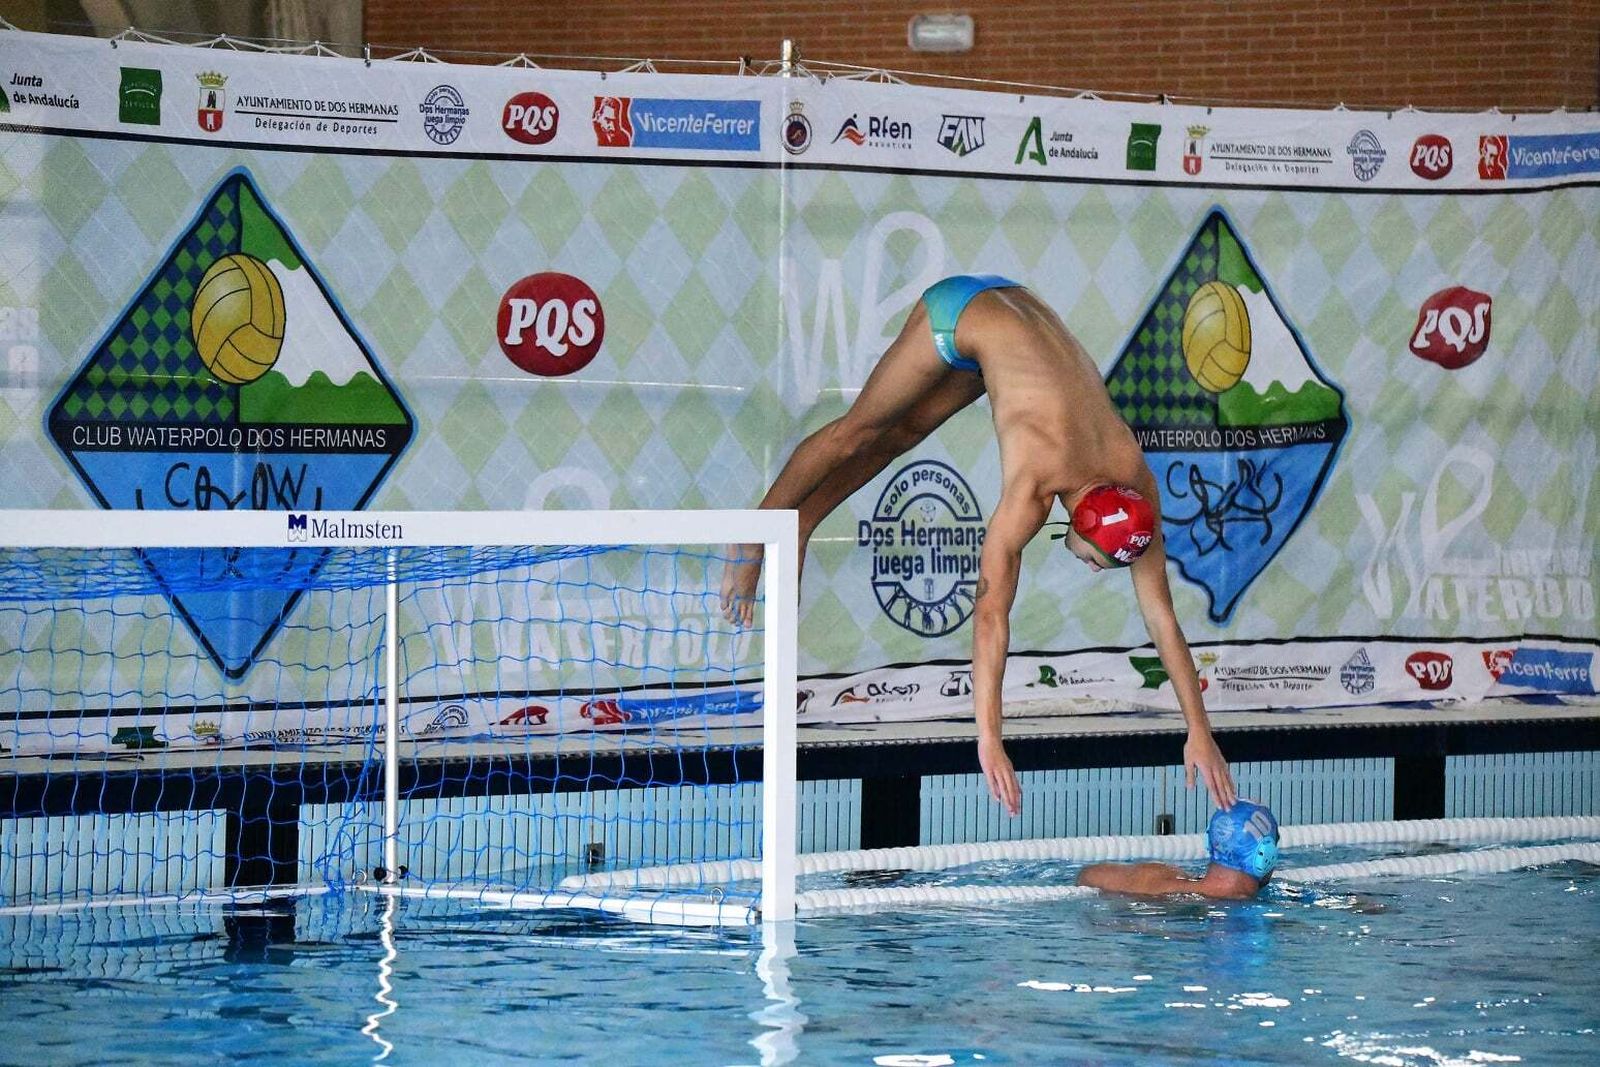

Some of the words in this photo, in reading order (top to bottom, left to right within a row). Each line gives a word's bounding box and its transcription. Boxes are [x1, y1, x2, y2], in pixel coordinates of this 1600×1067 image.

[10, 73, 43, 87] Junta
[13, 91, 27, 104] de
[29, 93, 80, 109] Andalucía
[236, 95, 312, 111] AYUNTAMIENTO
[314, 100, 326, 112] DE
[328, 101, 347, 113] DOS
[348, 102, 399, 116] HERMANAS
[434, 105, 470, 116] Hermanas
[255, 117, 311, 132] Delegación
[316, 120, 328, 132] de
[333, 122, 377, 135] Deportes
[505, 104, 556, 136] PQS
[636, 111, 755, 136] VicenteFerrer
[1049, 131, 1073, 141] Junta
[1049, 147, 1059, 157] de
[1060, 147, 1099, 159] Andalucía
[1210, 143, 1266, 155] AYUNTAMIENTO
[1267, 145, 1276, 155] DE
[1278, 145, 1292, 156] DOS
[1293, 147, 1332, 157] HERMANAS
[1412, 144, 1450, 172] PQS
[504, 298, 596, 357] PQS
[1412, 302, 1490, 353] PQS
[72, 425, 122, 447] CLUB
[128, 427, 241, 448] WATERPOLO
[247, 428, 285, 448] DOS
[290, 428, 387, 449] HERMANAS
[1136, 429, 1221, 449] WATERPOLO
[1225, 429, 1256, 447] DOS
[883, 479, 909, 516] solo
[911, 468, 971, 515] personas
[1101, 507, 1129, 526] 1
[310, 518, 404, 539] Malmsten
[858, 519, 894, 547] Dos
[900, 519, 986, 547] Hermana
[1129, 534, 1152, 548] PQS
[871, 546, 925, 581] juega
